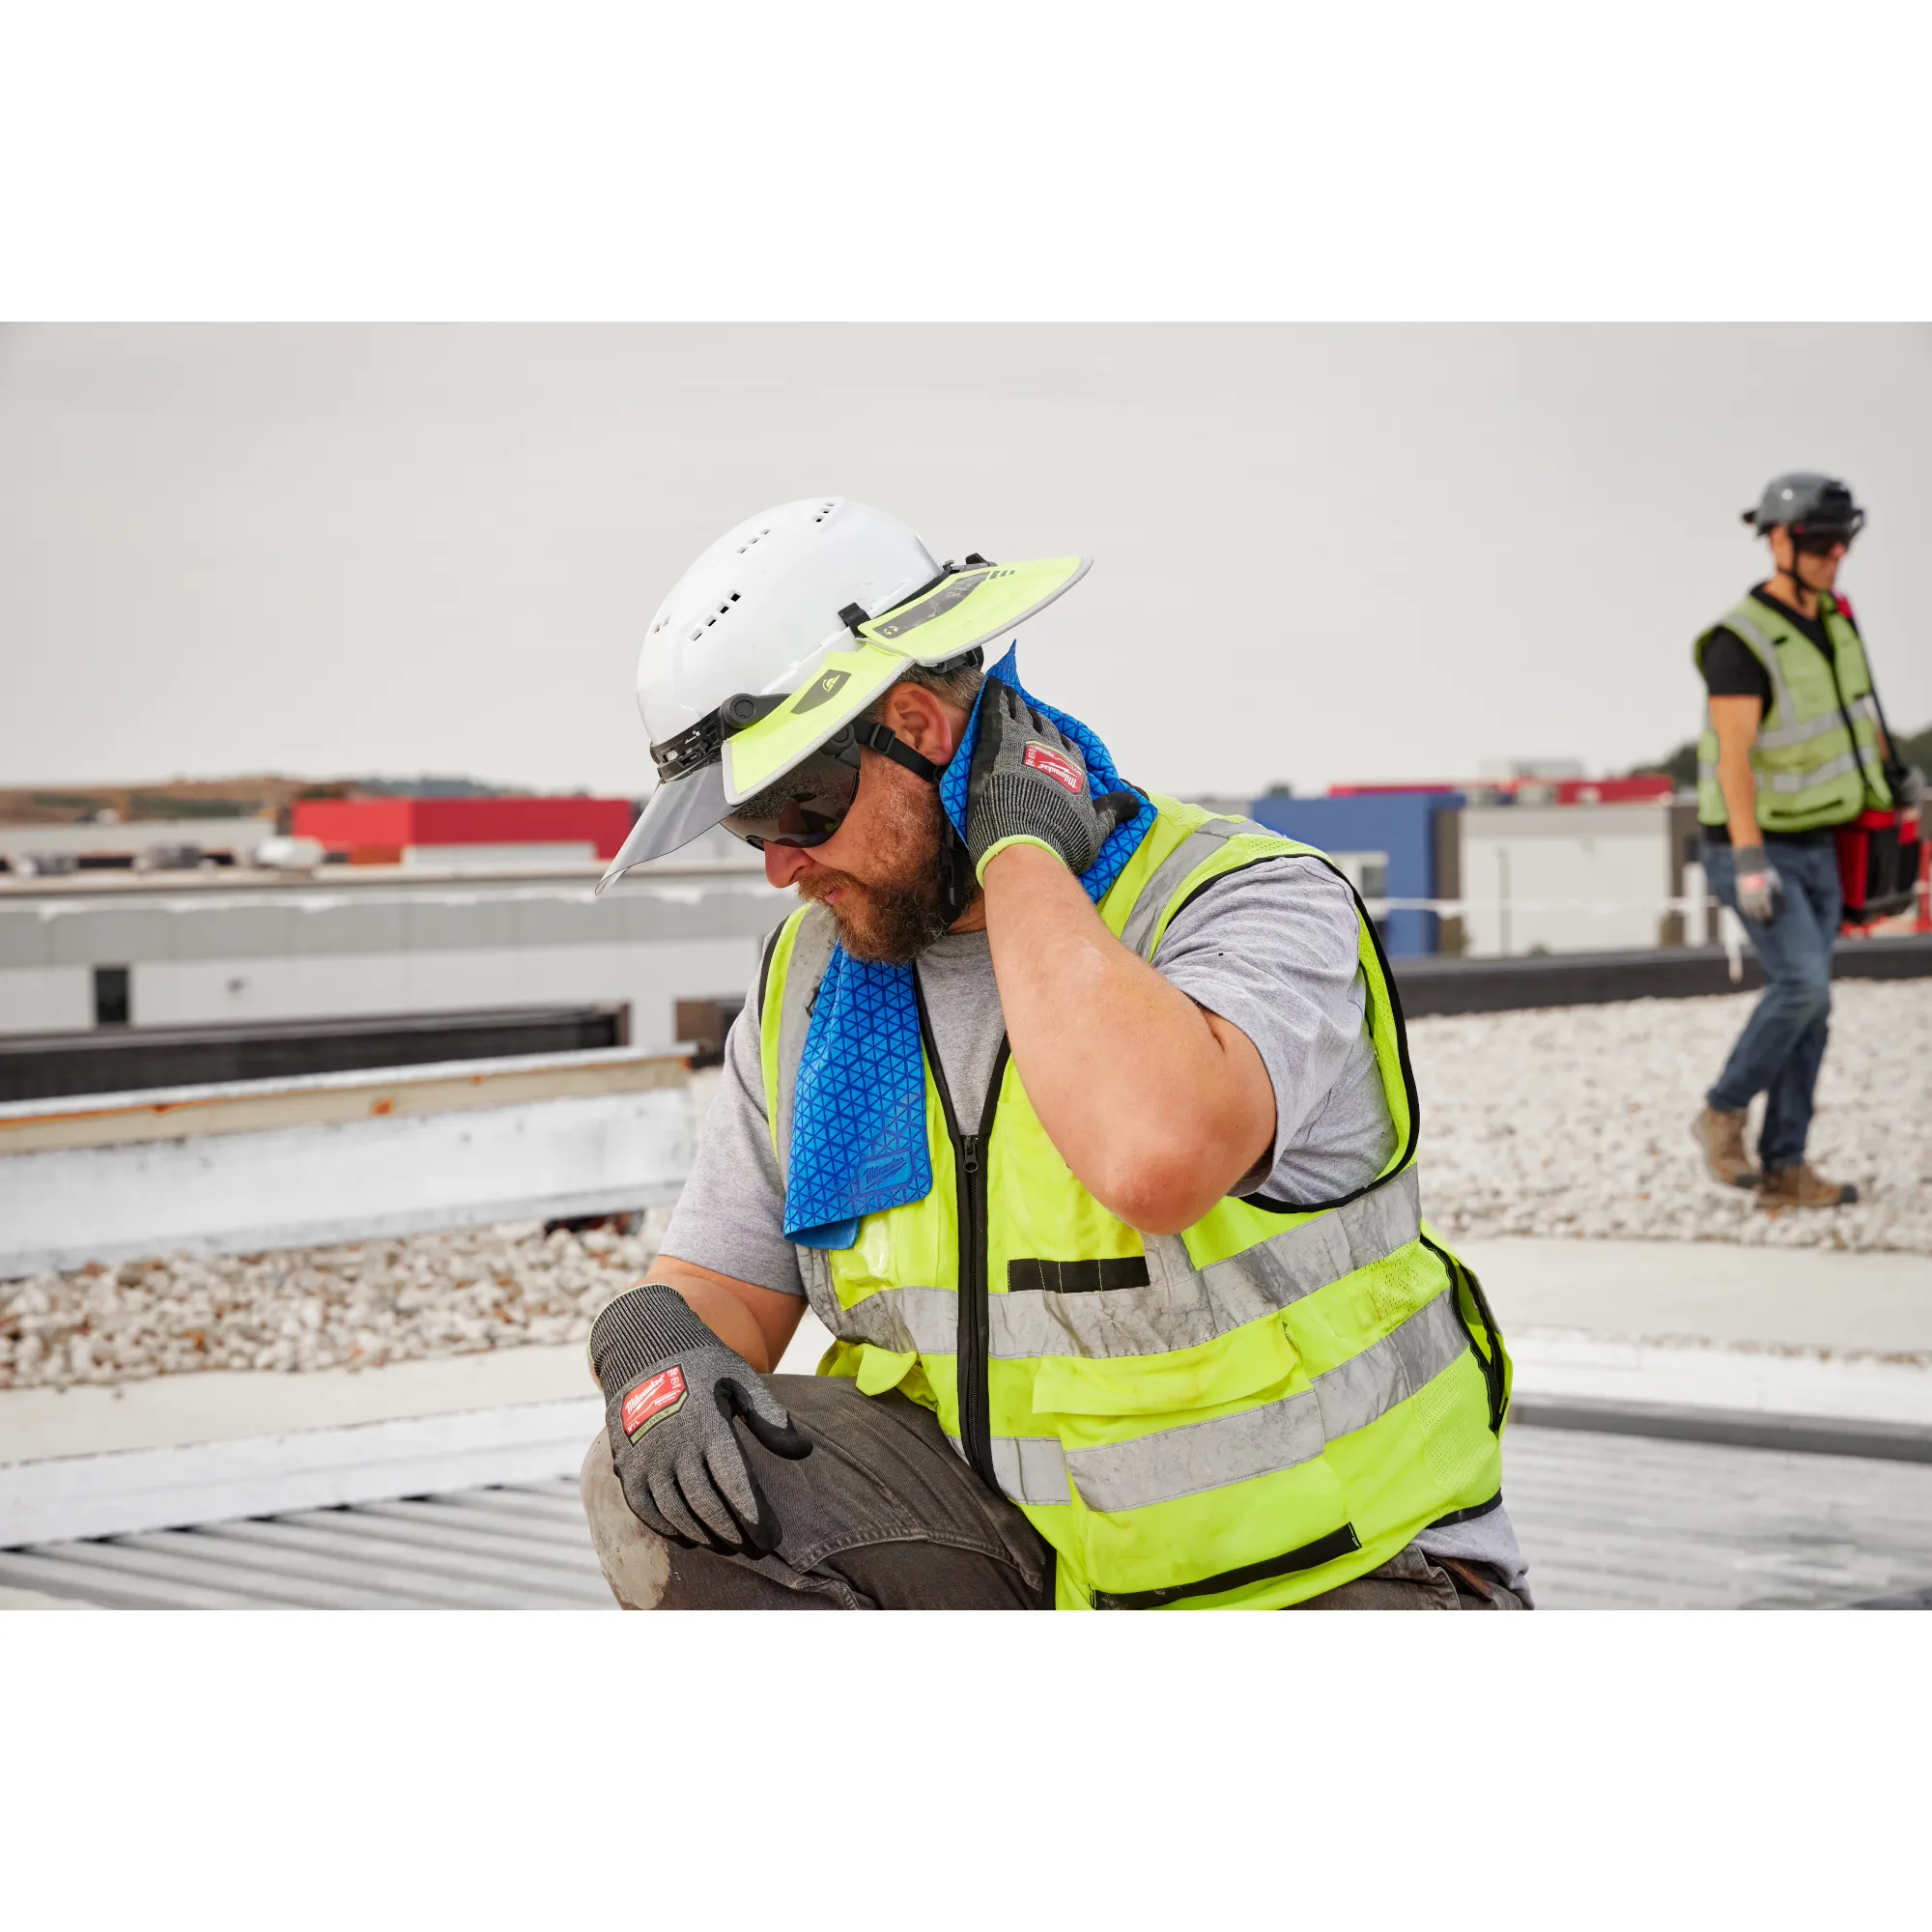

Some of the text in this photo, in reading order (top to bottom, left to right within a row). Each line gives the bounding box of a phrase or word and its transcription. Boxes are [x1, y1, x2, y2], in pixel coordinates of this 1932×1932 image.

[1037, 764, 1078, 788] Milwaukee
[625, 1375, 665, 1414] Milwaukee
[647, 1415, 664, 1427] LEVEL
